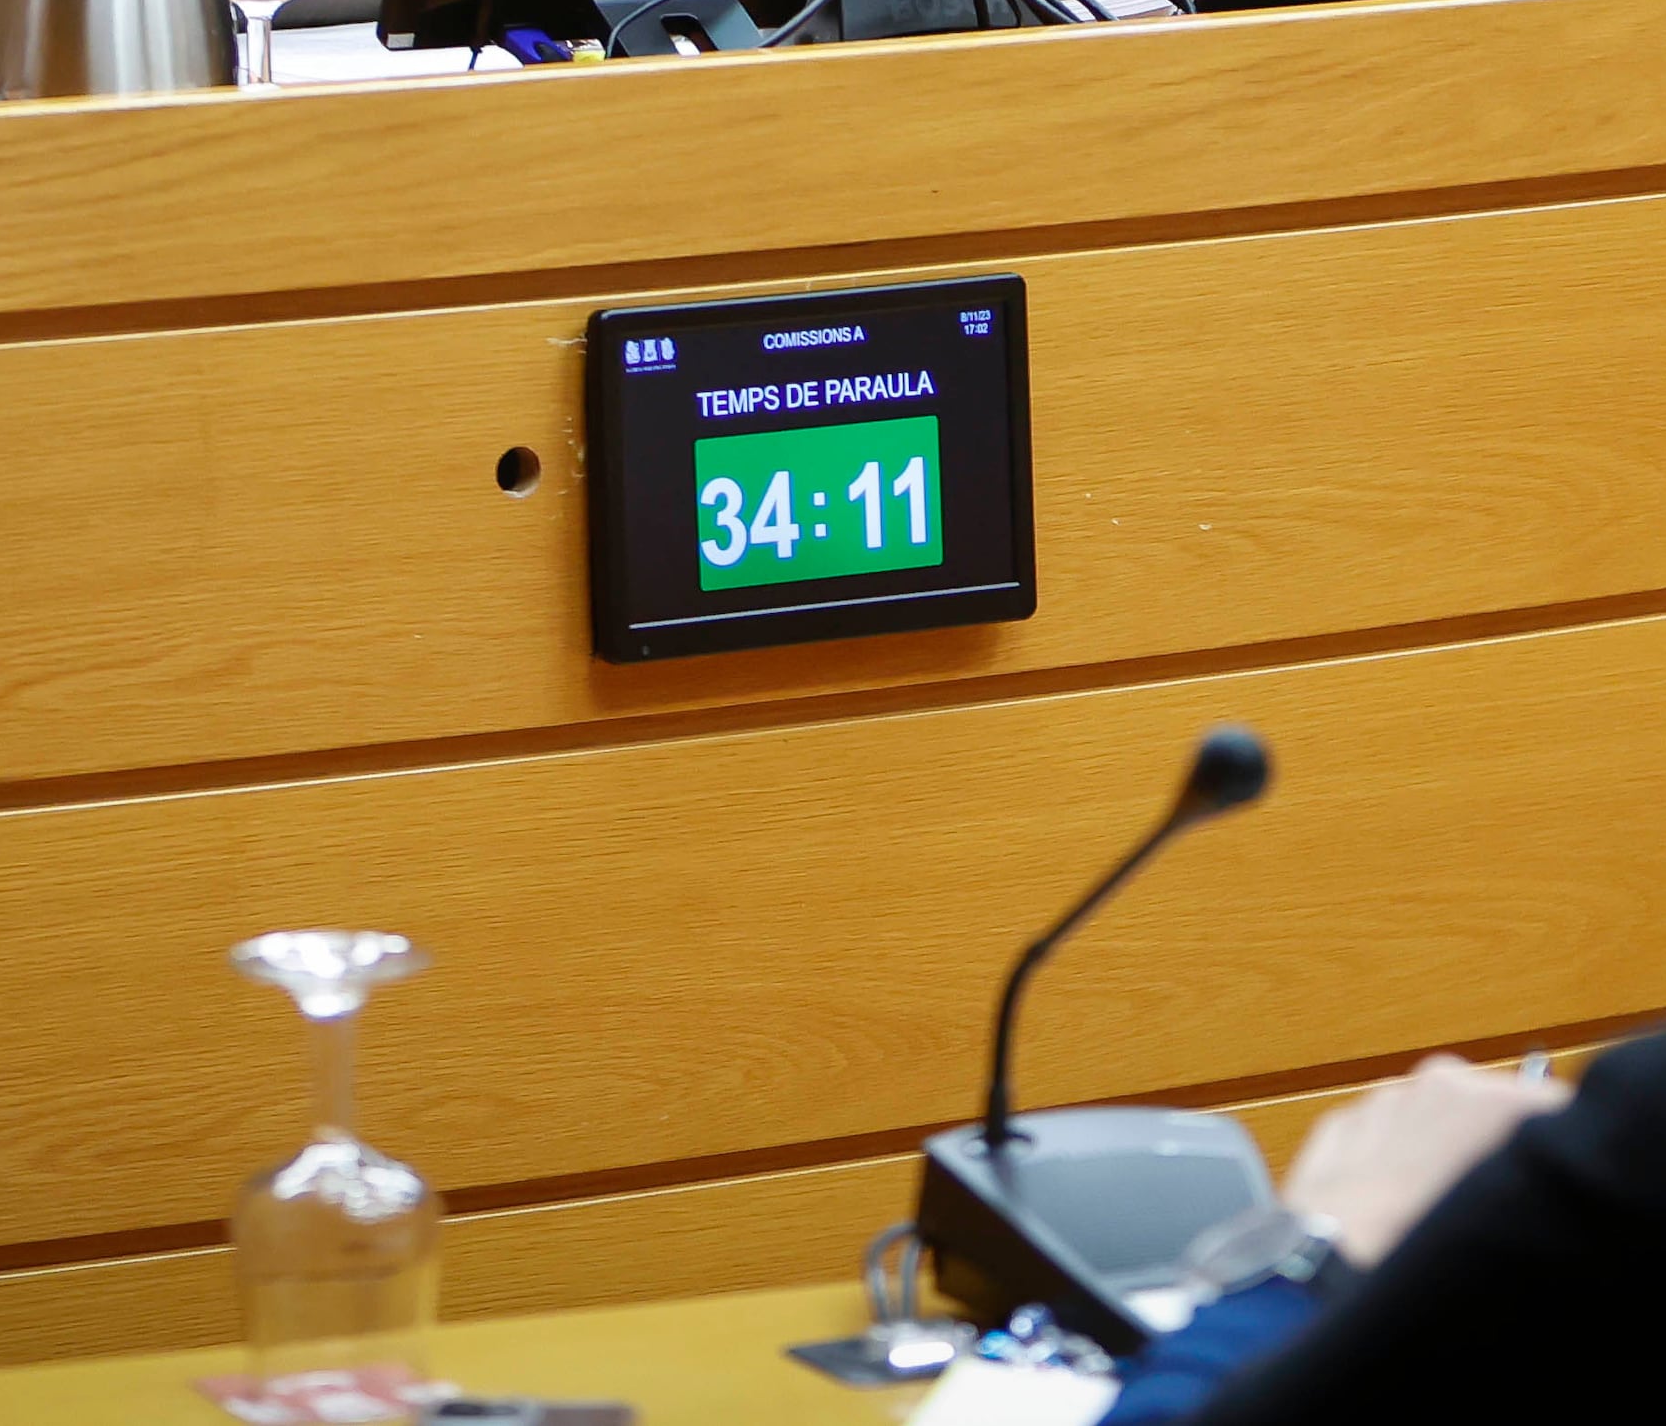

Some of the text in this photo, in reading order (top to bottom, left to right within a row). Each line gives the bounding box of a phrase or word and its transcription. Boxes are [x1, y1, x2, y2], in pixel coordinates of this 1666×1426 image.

[763, 325, 865, 350] COMISSIONS A
[964, 322, 989, 335] 17:02
[696, 370, 934, 417] TEMPS DE PARAULA
[700, 456, 928, 566] 34:11
